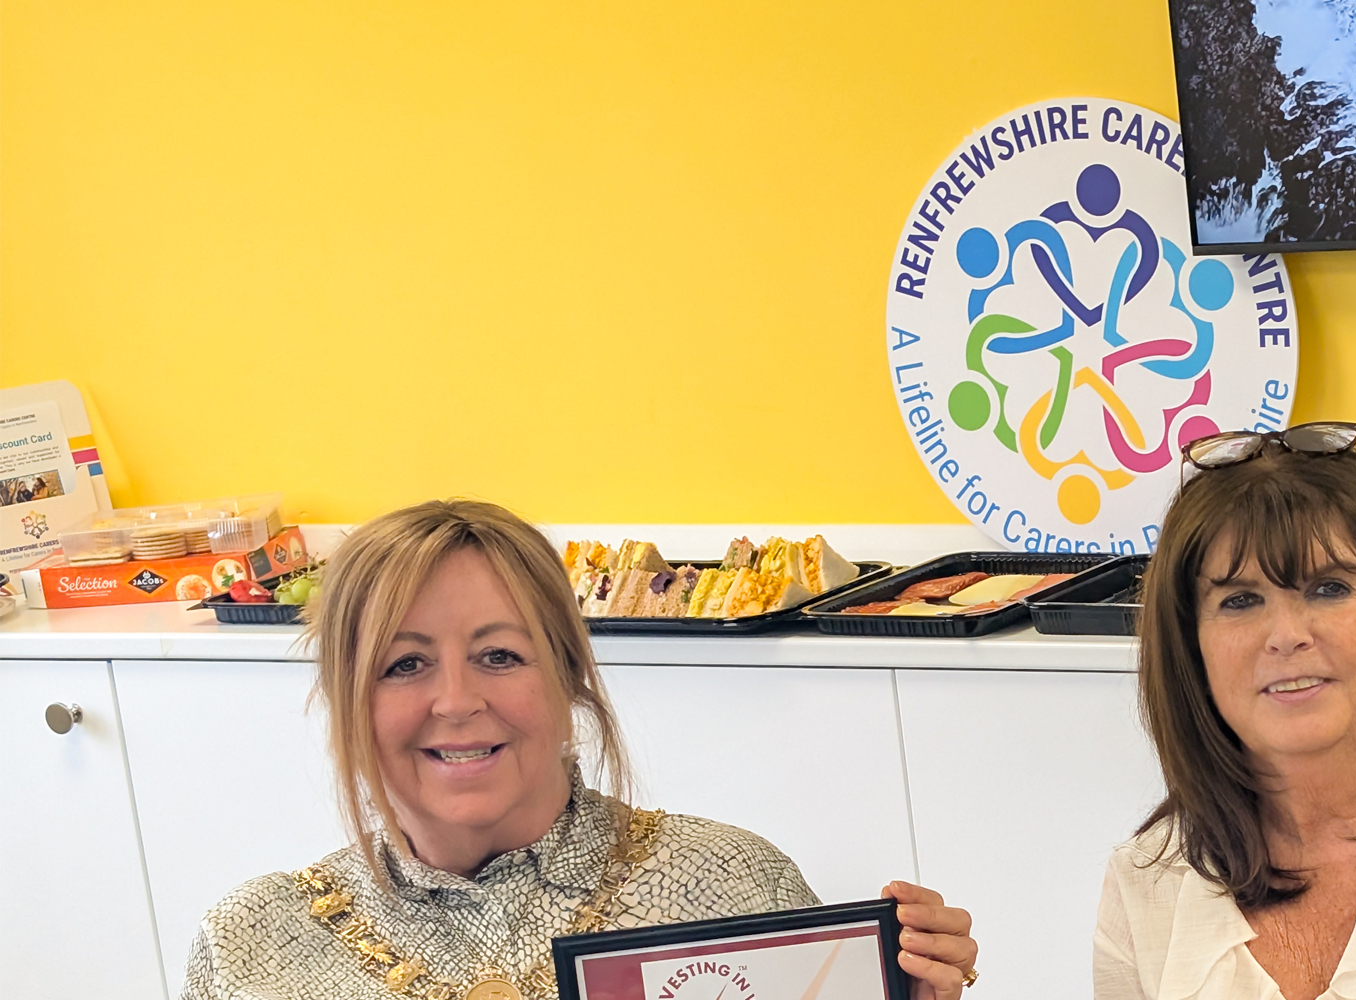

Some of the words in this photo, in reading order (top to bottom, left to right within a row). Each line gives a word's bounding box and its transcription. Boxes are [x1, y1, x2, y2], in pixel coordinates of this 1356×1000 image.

[895, 104, 1090, 300] RENFREWSHIRE
[1101, 106, 1186, 178] CARE
[1242, 253, 1290, 348] NTRE
[891, 326, 921, 351] A
[895, 361, 960, 484] Lifeline
[0, 436, 29, 451] count
[30, 431, 53, 444] Card
[955, 474, 1001, 525] for
[1109, 533, 1136, 556] in
[57, 576, 118, 593] Selection
[731, 972, 751, 992] IN
